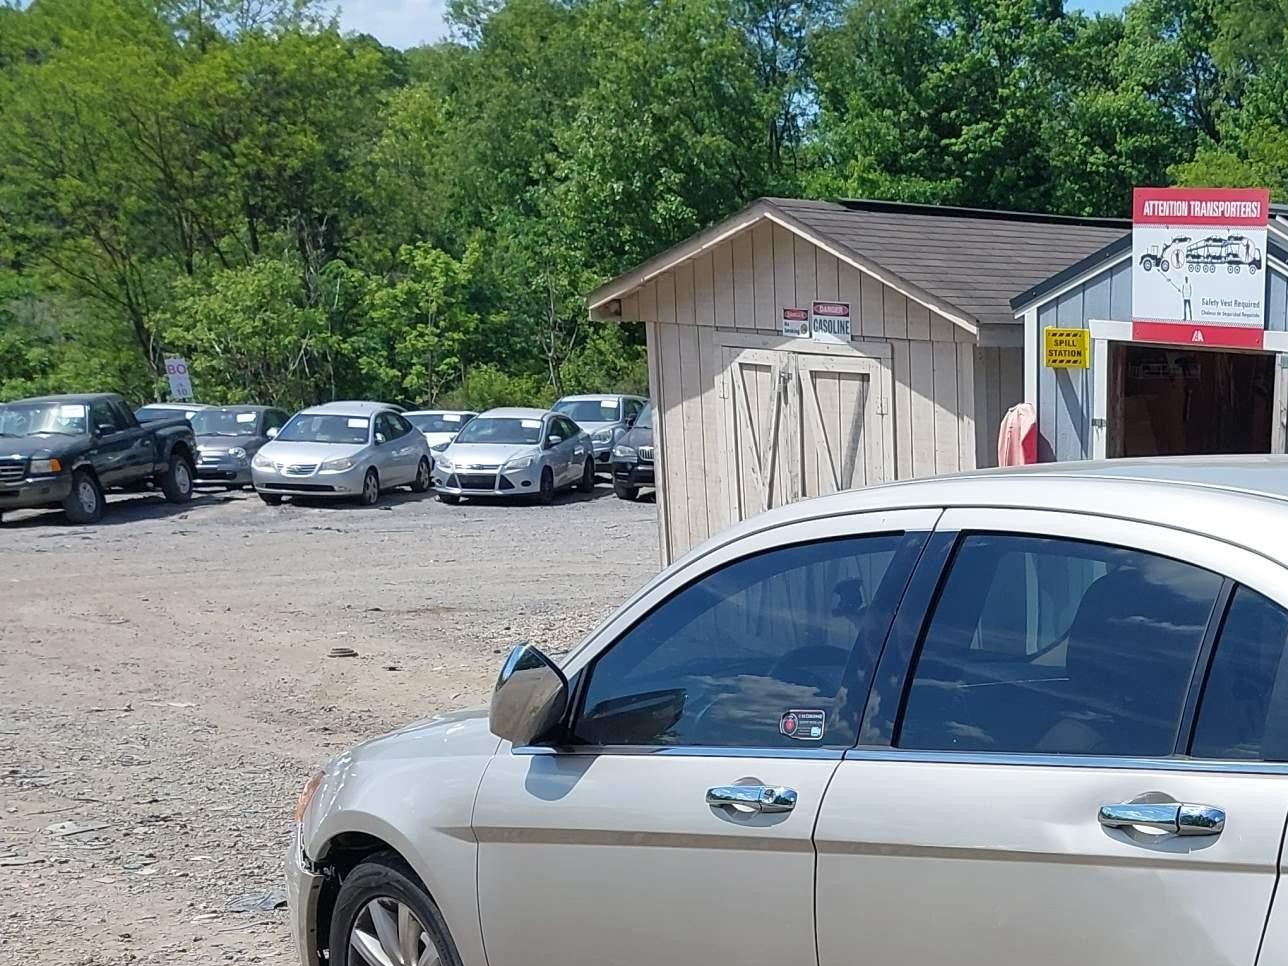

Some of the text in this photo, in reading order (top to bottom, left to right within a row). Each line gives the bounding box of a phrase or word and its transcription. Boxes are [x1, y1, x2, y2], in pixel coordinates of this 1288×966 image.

[1143, 200, 1261, 218] ATTENTION TRANSPORTERS!
[1201, 297, 1260, 310] Safety Vest Required
[813, 318, 850, 335] GASOLINE
[1053, 339, 1077, 347] SPILL
[1048, 349, 1082, 357] STATION
